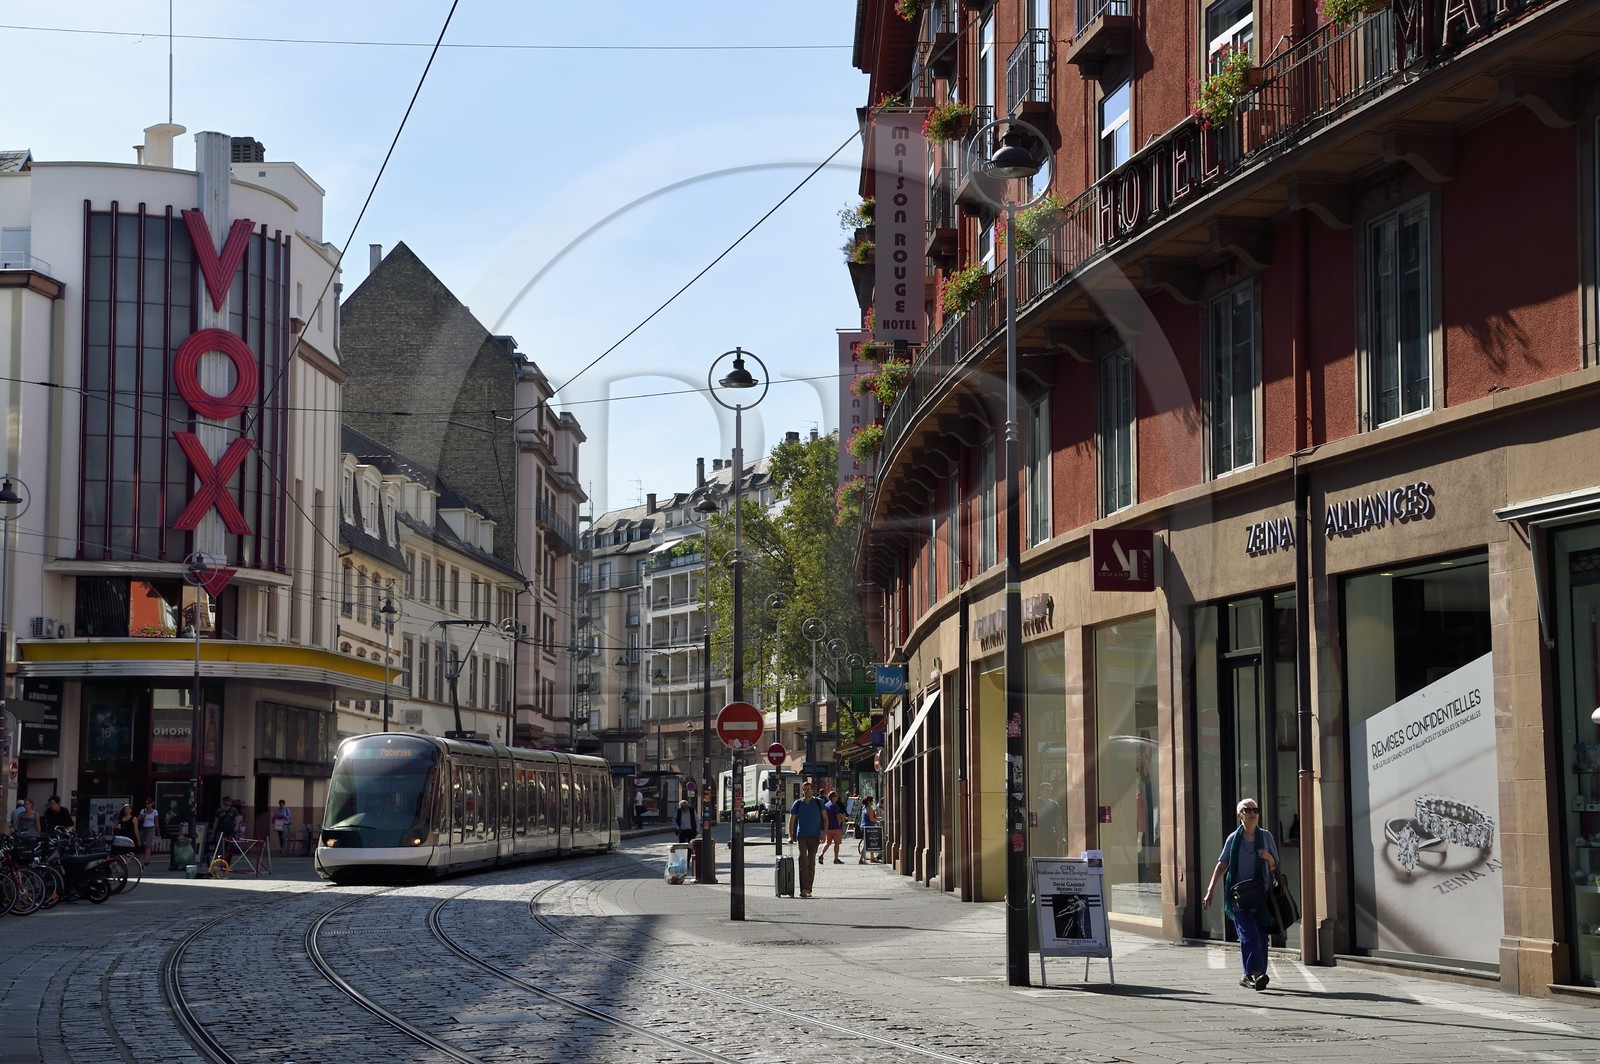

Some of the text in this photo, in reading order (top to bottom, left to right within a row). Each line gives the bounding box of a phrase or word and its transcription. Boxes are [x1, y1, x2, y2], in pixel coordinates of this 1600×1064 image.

[890, 125, 910, 314] MAISON ROUGE
[1097, 122, 1224, 248] HOTEL
[882, 318, 918, 331] HOTEL
[172, 208, 258, 536] VOX
[1246, 481, 1432, 555] ZEINA ALLIANCES
[878, 675, 900, 687] Krys
[1371, 688, 1482, 760] REMISES CONFIDENTIELLES
[1433, 870, 1486, 895] ZEINA
